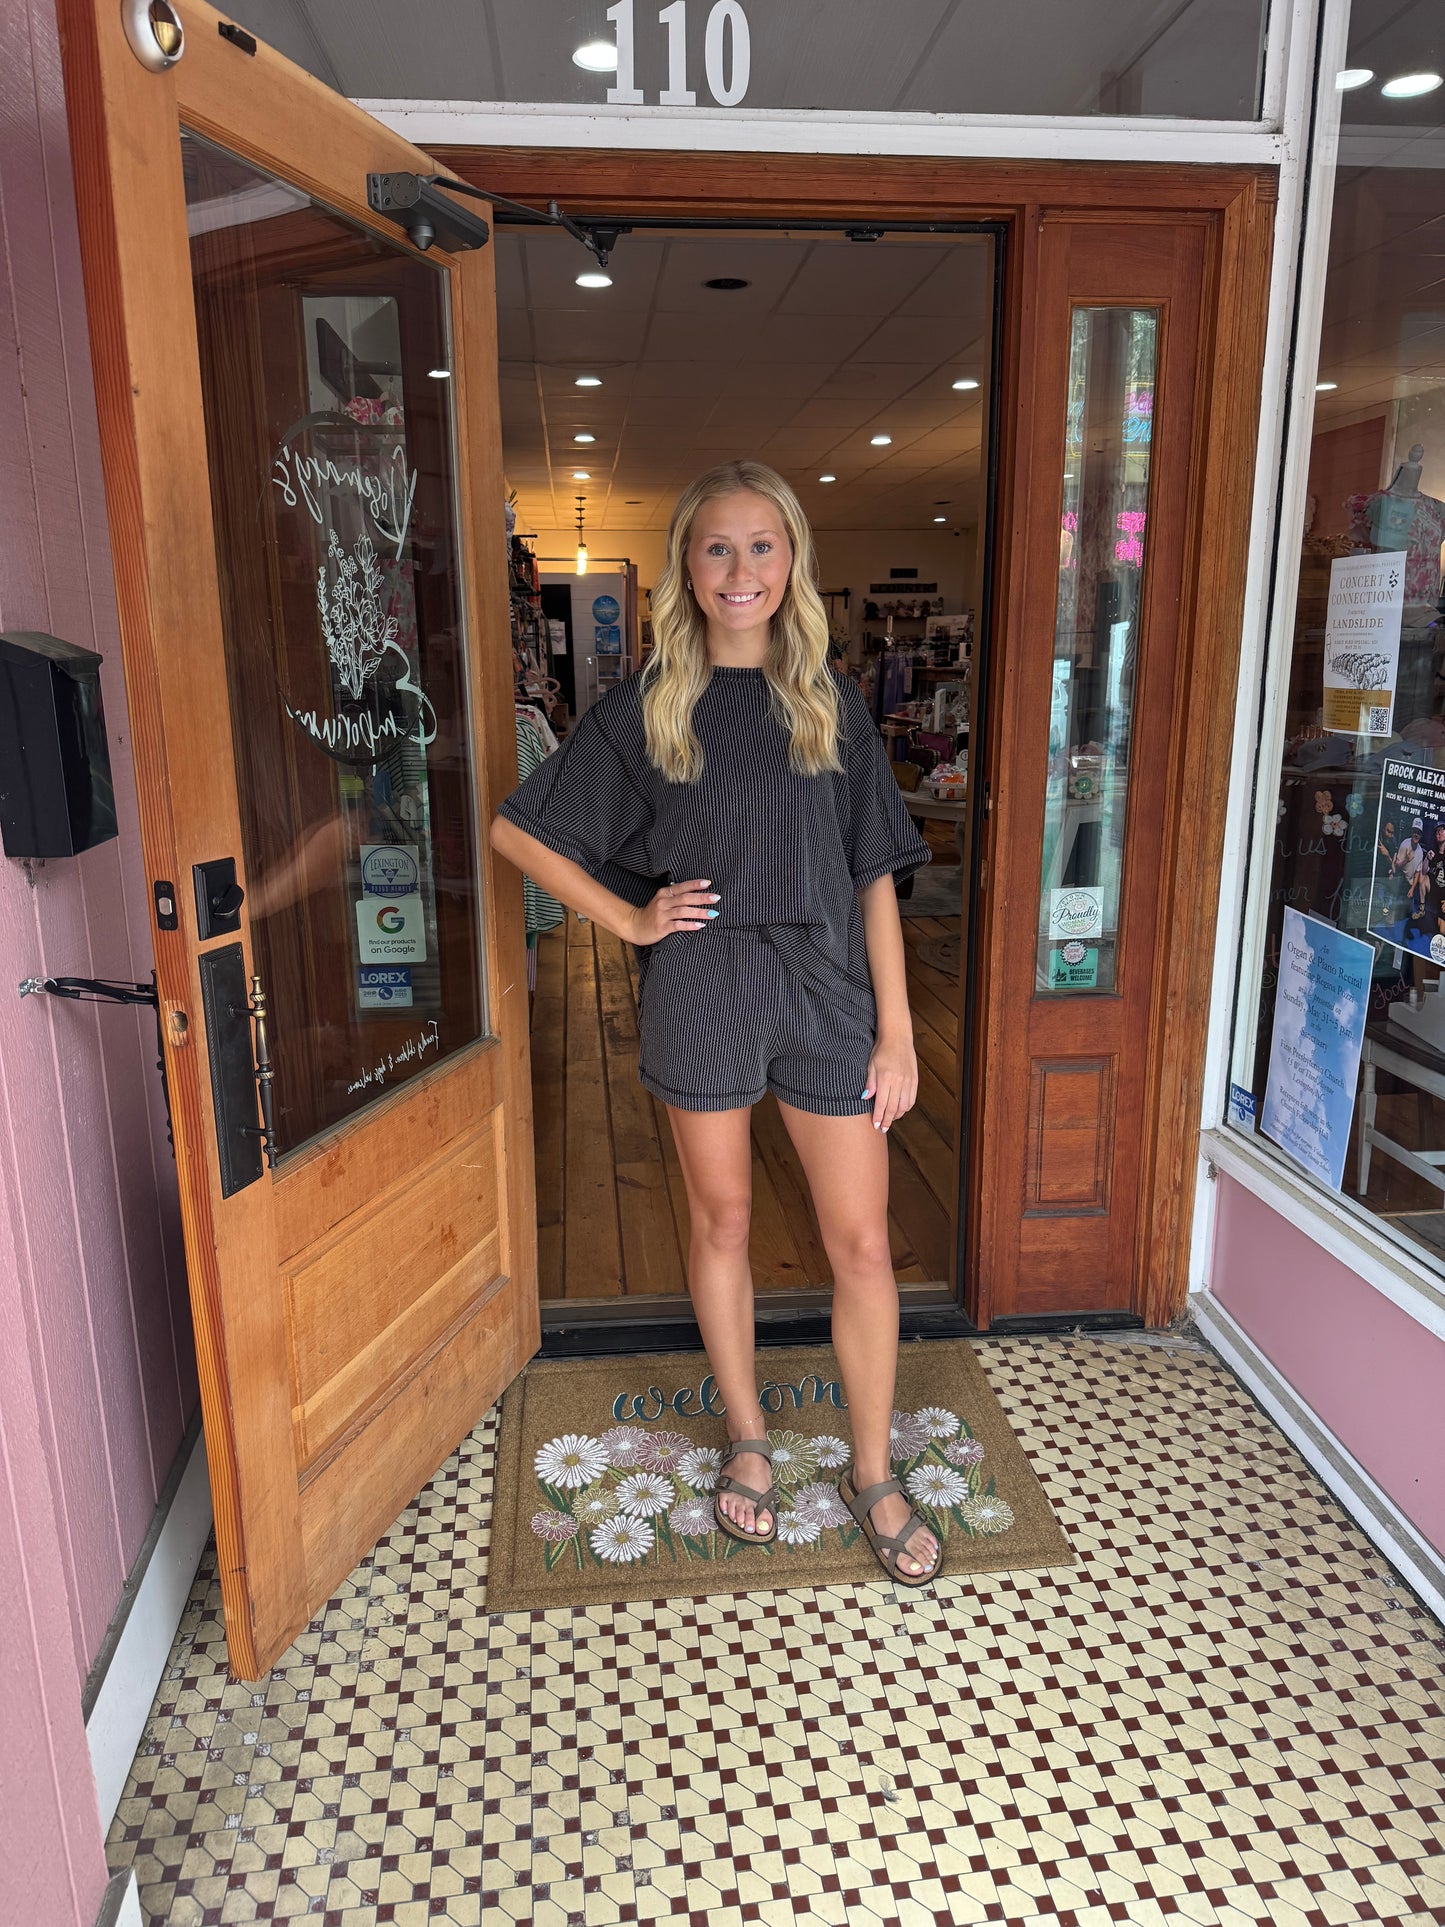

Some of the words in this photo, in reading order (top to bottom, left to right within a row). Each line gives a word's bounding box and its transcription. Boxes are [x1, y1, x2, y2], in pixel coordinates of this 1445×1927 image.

[606, 0, 750, 106] 110
[1340, 574, 1385, 589] CONCERT
[1332, 590, 1394, 606] CONNECTION
[1333, 618, 1384, 629] LANDSLIDE
[1388, 764, 1415, 780] BROCK
[371, 859, 409, 871] LEXINGTON
[1052, 905, 1099, 924] Proudly
[384, 945, 416, 955] Google
[391, 938, 417, 946] products
[1287, 941, 1308, 960] Organ
[1317, 956, 1337, 975] Piano
[1338, 967, 1363, 990] Recital
[361, 972, 407, 985] LOREX
[1283, 989, 1306, 1012] Sunday,
[1307, 1003, 1320, 1021] May
[1325, 1069, 1345, 1089] Church
[1232, 1088, 1254, 1111] LOREX
[612, 1374, 848, 1422] welom
